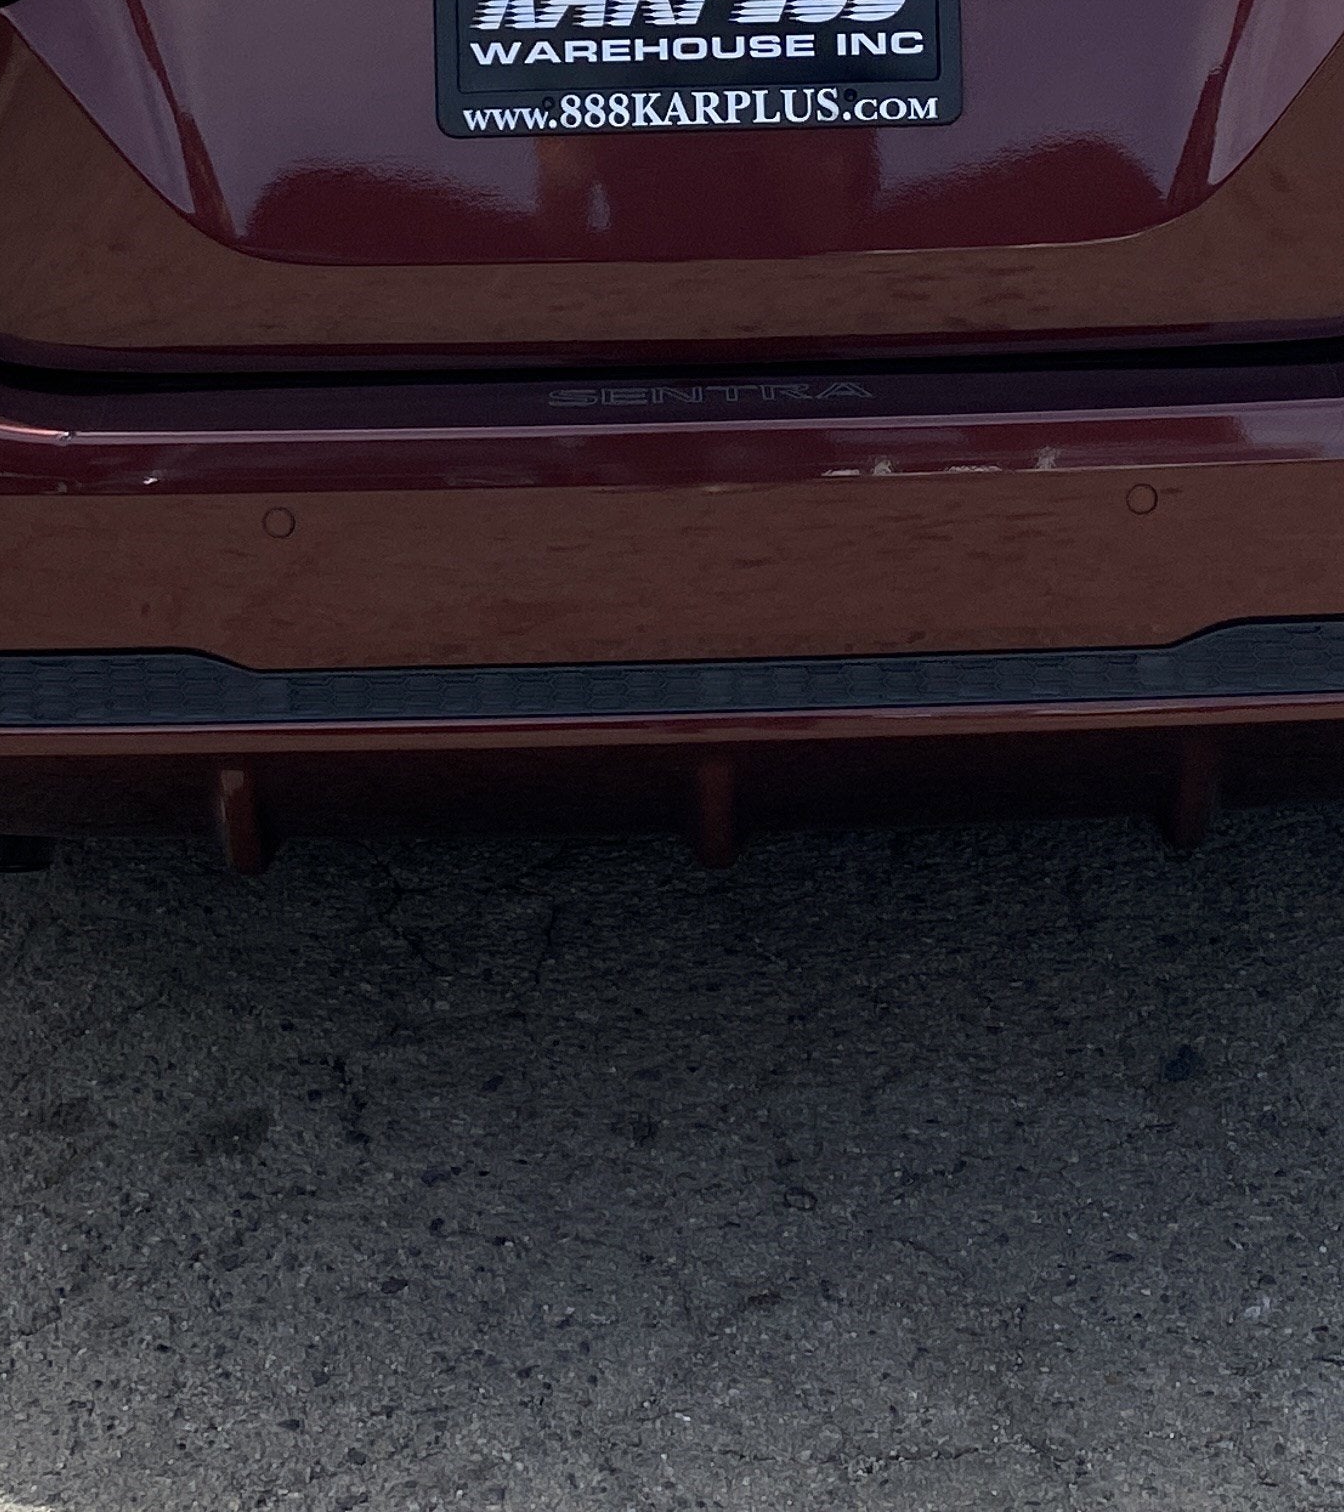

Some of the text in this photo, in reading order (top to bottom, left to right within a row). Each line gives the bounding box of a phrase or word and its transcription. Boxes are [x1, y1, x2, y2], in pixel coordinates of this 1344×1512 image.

[469, 31, 924, 65] WAREHOUSE INC
[548, 382, 872, 407] SENTRA
